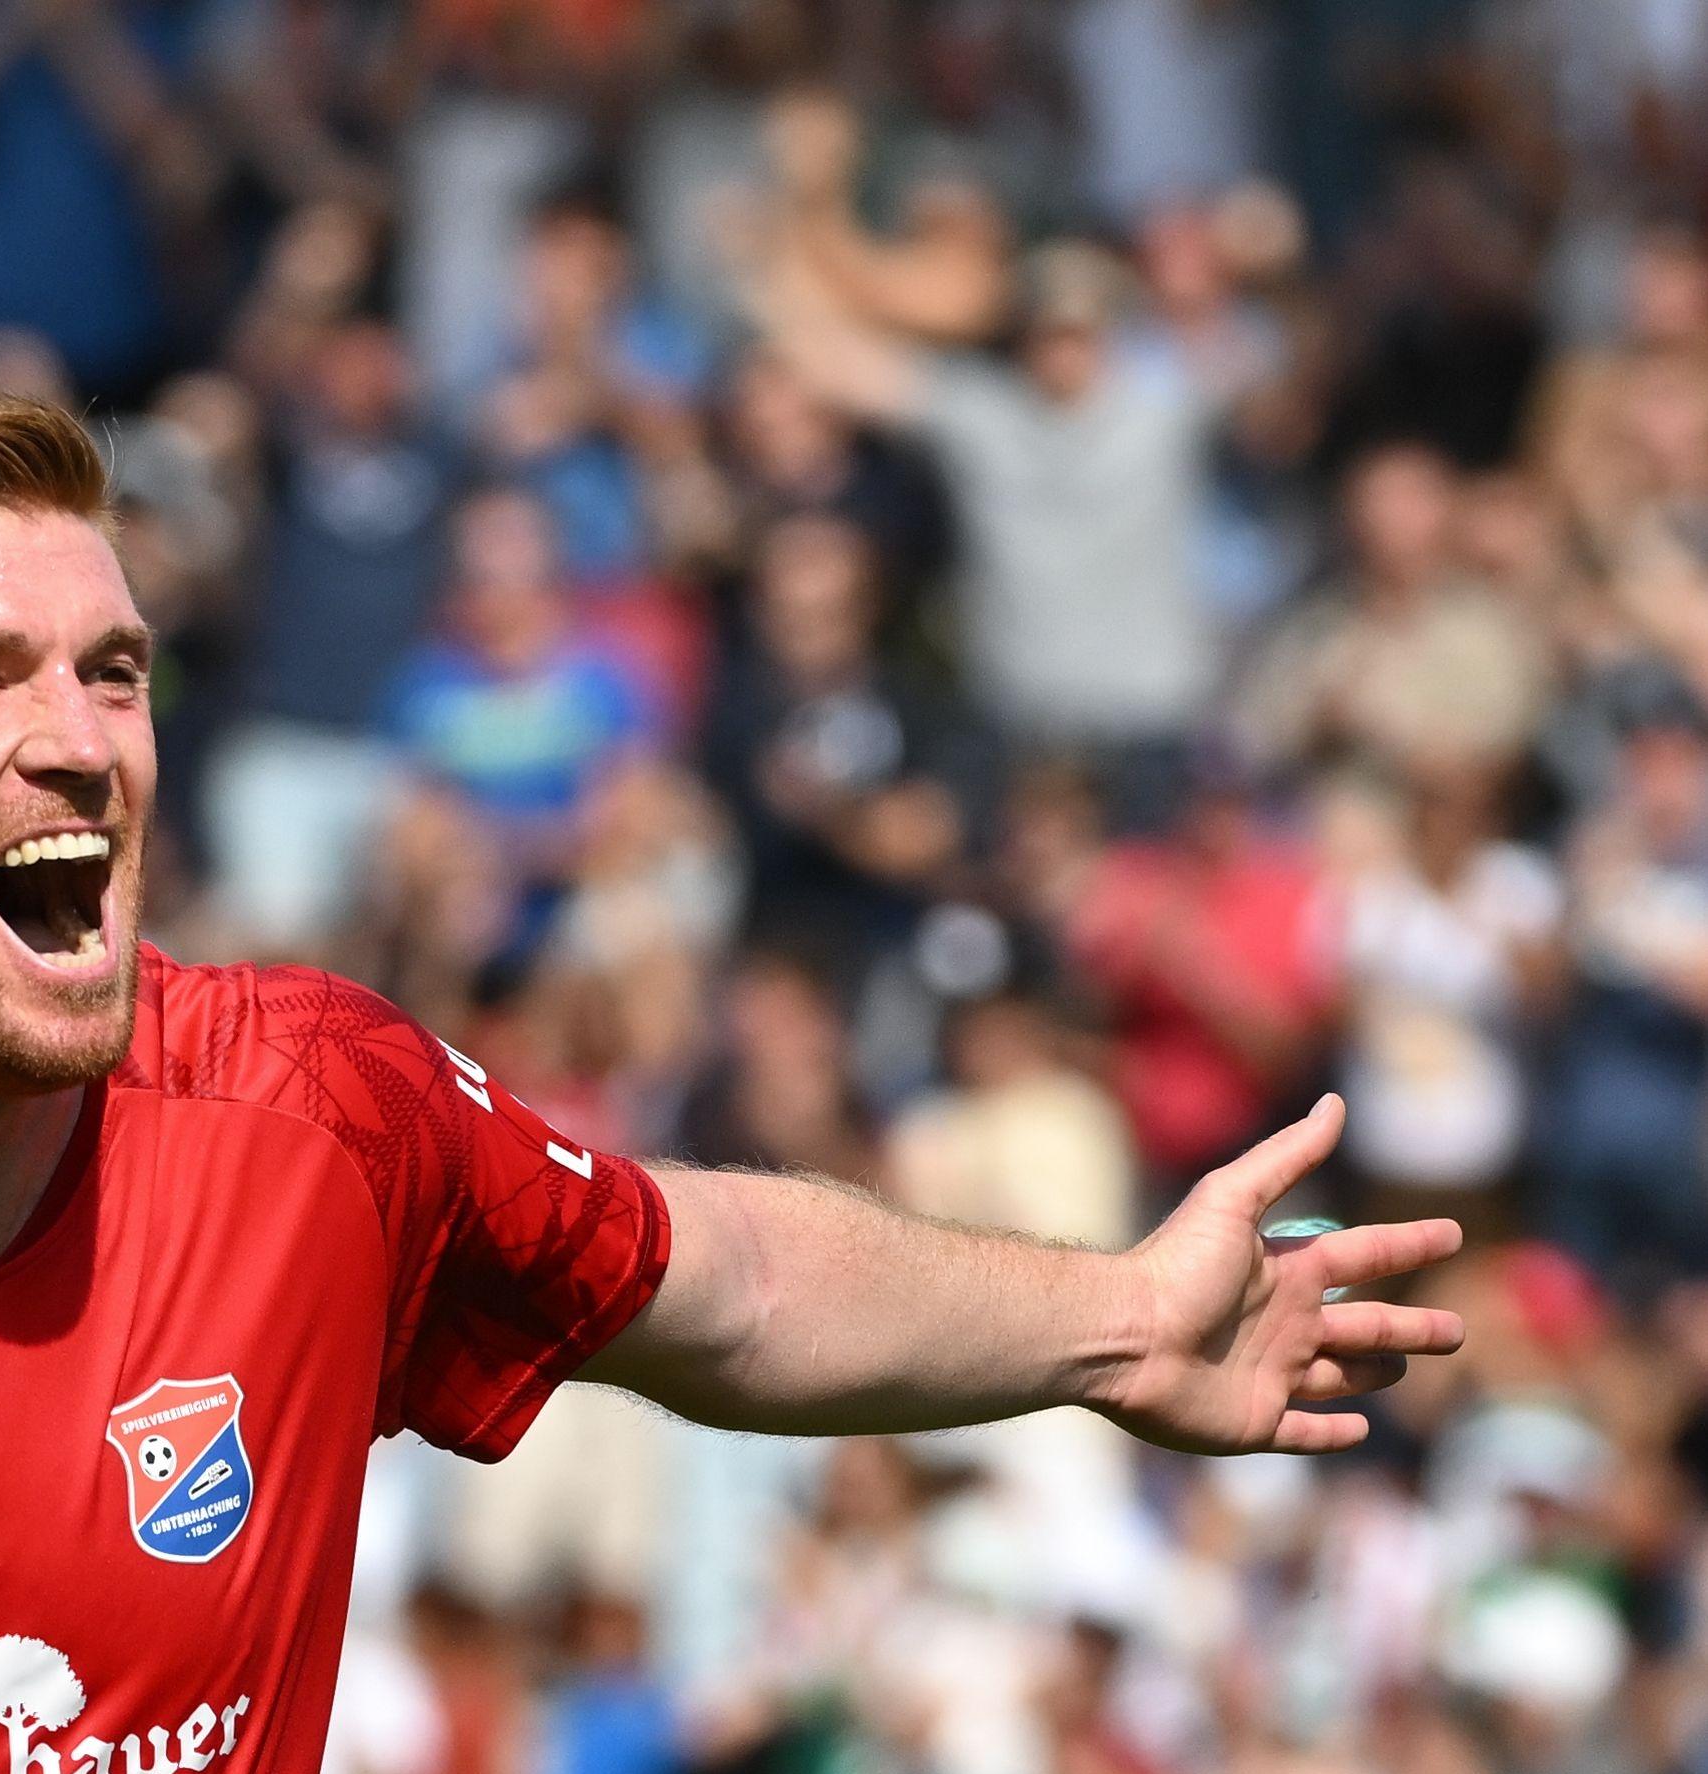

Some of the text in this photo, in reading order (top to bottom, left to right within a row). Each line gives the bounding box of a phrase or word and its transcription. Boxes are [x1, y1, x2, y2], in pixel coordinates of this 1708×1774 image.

[120, 1392, 229, 1436] SPIELVEREINIGUNG
[151, 1494, 242, 1536] UNTERHACHING
[190, 1522, 214, 1539] 1925
